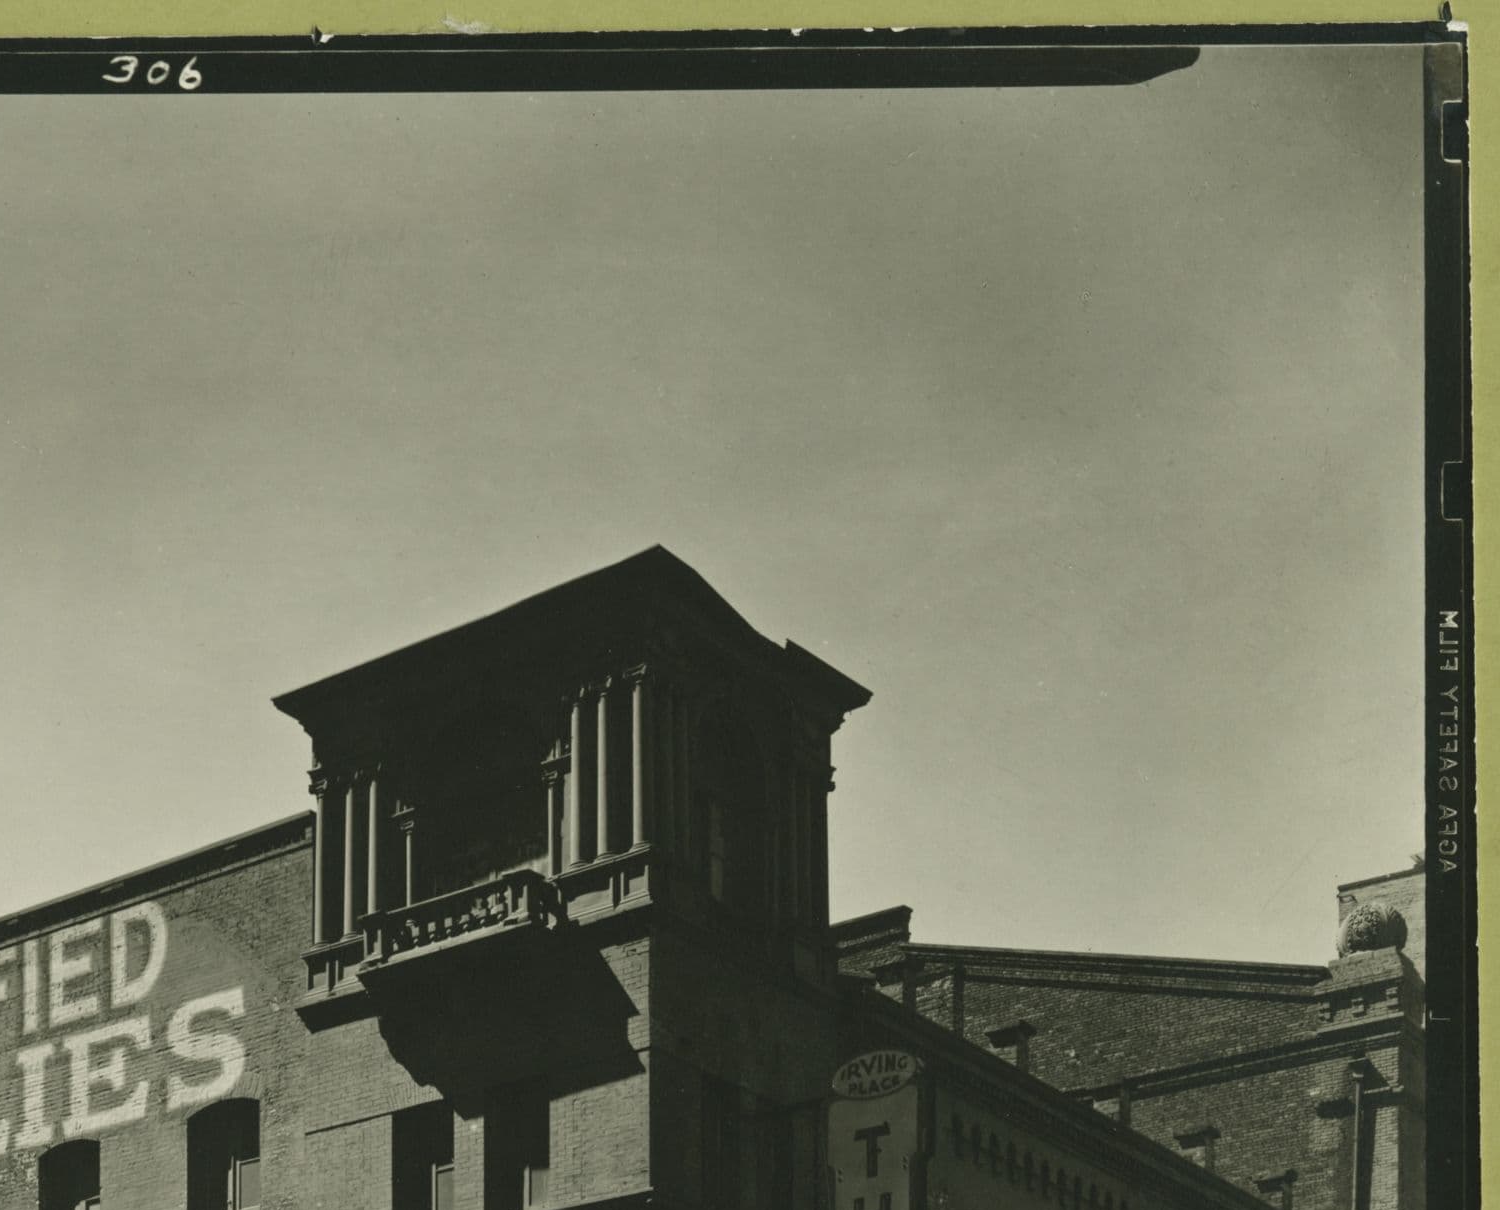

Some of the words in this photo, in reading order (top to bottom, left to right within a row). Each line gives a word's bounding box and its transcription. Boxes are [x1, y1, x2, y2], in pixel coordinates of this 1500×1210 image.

[102, 55, 202, 90] 306
[840, 1053, 910, 1083] IRVING
[848, 1074, 903, 1097] PLACE
